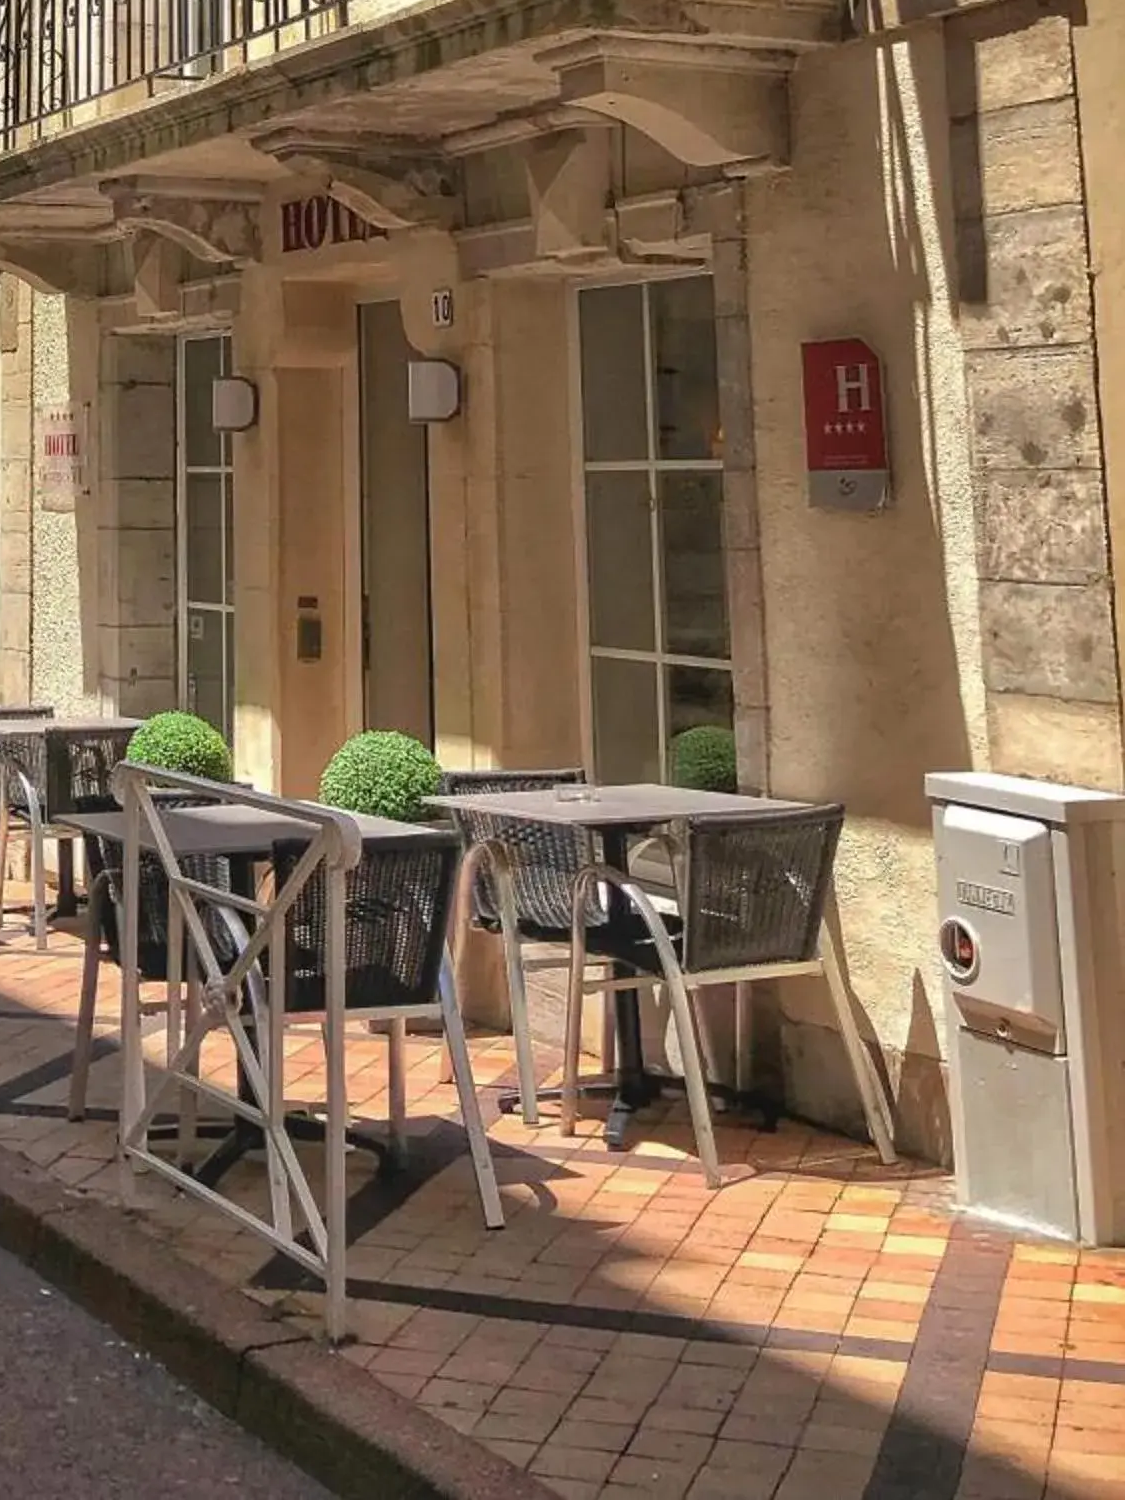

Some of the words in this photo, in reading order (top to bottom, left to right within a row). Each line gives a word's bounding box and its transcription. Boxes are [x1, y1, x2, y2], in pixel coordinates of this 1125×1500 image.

[281, 196, 389, 252] HOTE
[434, 295, 450, 322] 10
[835, 363, 872, 413] H
[44, 434, 79, 456] HOTEL
